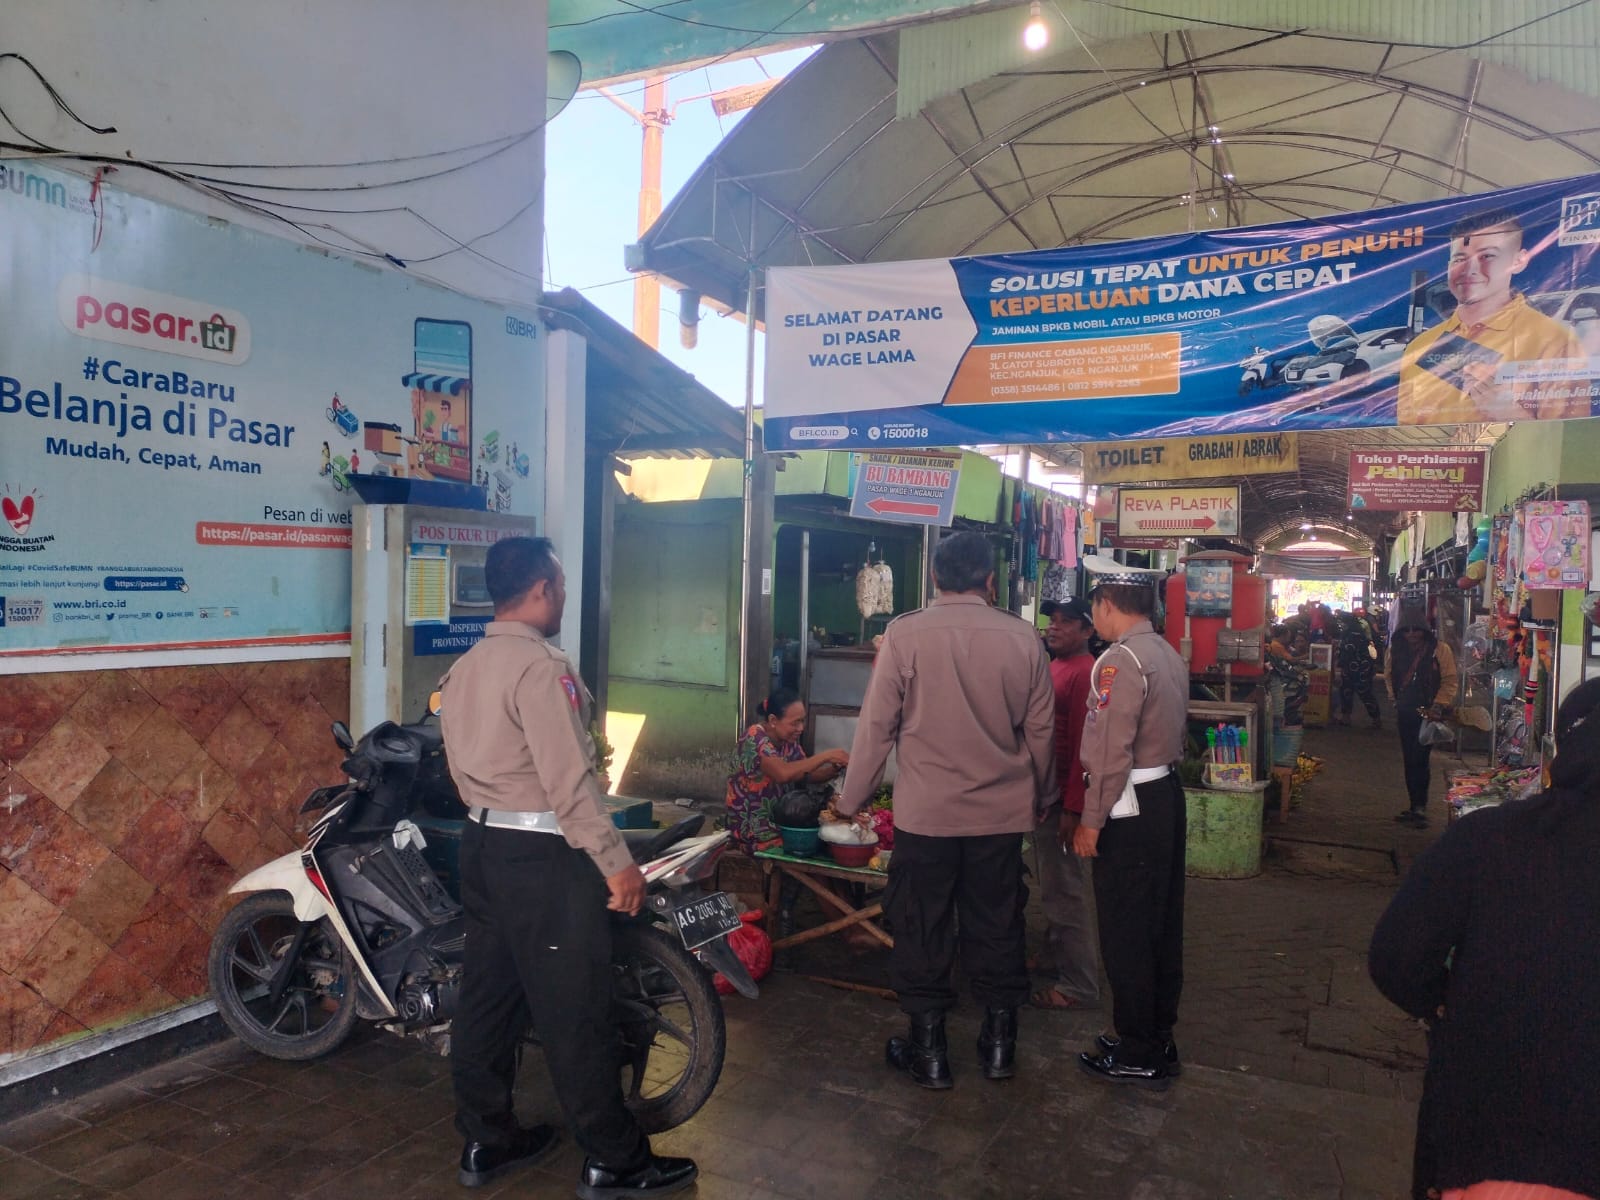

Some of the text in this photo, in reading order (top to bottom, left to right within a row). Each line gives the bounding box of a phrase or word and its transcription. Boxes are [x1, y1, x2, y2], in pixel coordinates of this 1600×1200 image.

[989, 225, 1424, 293] SOLUSI TEPAT UNTUK PENUHI
[989, 262, 1356, 317] KEPERLUAN DANA CEPAT
[784, 306, 943, 327] SELAMAT DATANG
[992, 308, 1221, 336] JAMINAN BPKB MOBIL ATAU BPKB MOTOR
[518, 322, 537, 340] BRI
[823, 329, 901, 346] DI PASAR
[808, 349, 916, 367] WAGE LAMA
[991, 352, 1006, 361] BFI
[1008, 350, 1052, 360] FINANCE
[1002, 360, 1035, 370] GATOT
[1036, 357, 1085, 368] SUBROTO
[83, 356, 236, 402] #CaraBaru
[0, 375, 296, 448] Belanja di Pasar
[882, 427, 929, 439] 1500018
[46, 436, 262, 474] Mudah, Cepat, Aman
[1097, 446, 1164, 467] TOILET
[1188, 441, 1233, 461] GRABAH
[1243, 437, 1282, 457] ABRAK
[1356, 454, 1478, 464] Toko Perhiasan
[866, 465, 951, 488] BU BAMBANG
[1367, 465, 1465, 483] Pahlevy
[1124, 497, 1164, 512] REVA
[1170, 497, 1233, 511] PLASTIK
[264, 506, 305, 522] Pesan
[311, 508, 323, 523] di
[22, 534, 55, 545] BUATAN
[419, 525, 445, 540] POS
[448, 527, 483, 542] UKUR
[53, 599, 127, 609] www.bri.co.id
[432, 636, 469, 648] PROVINSI
[678, 907, 696, 929] AG
